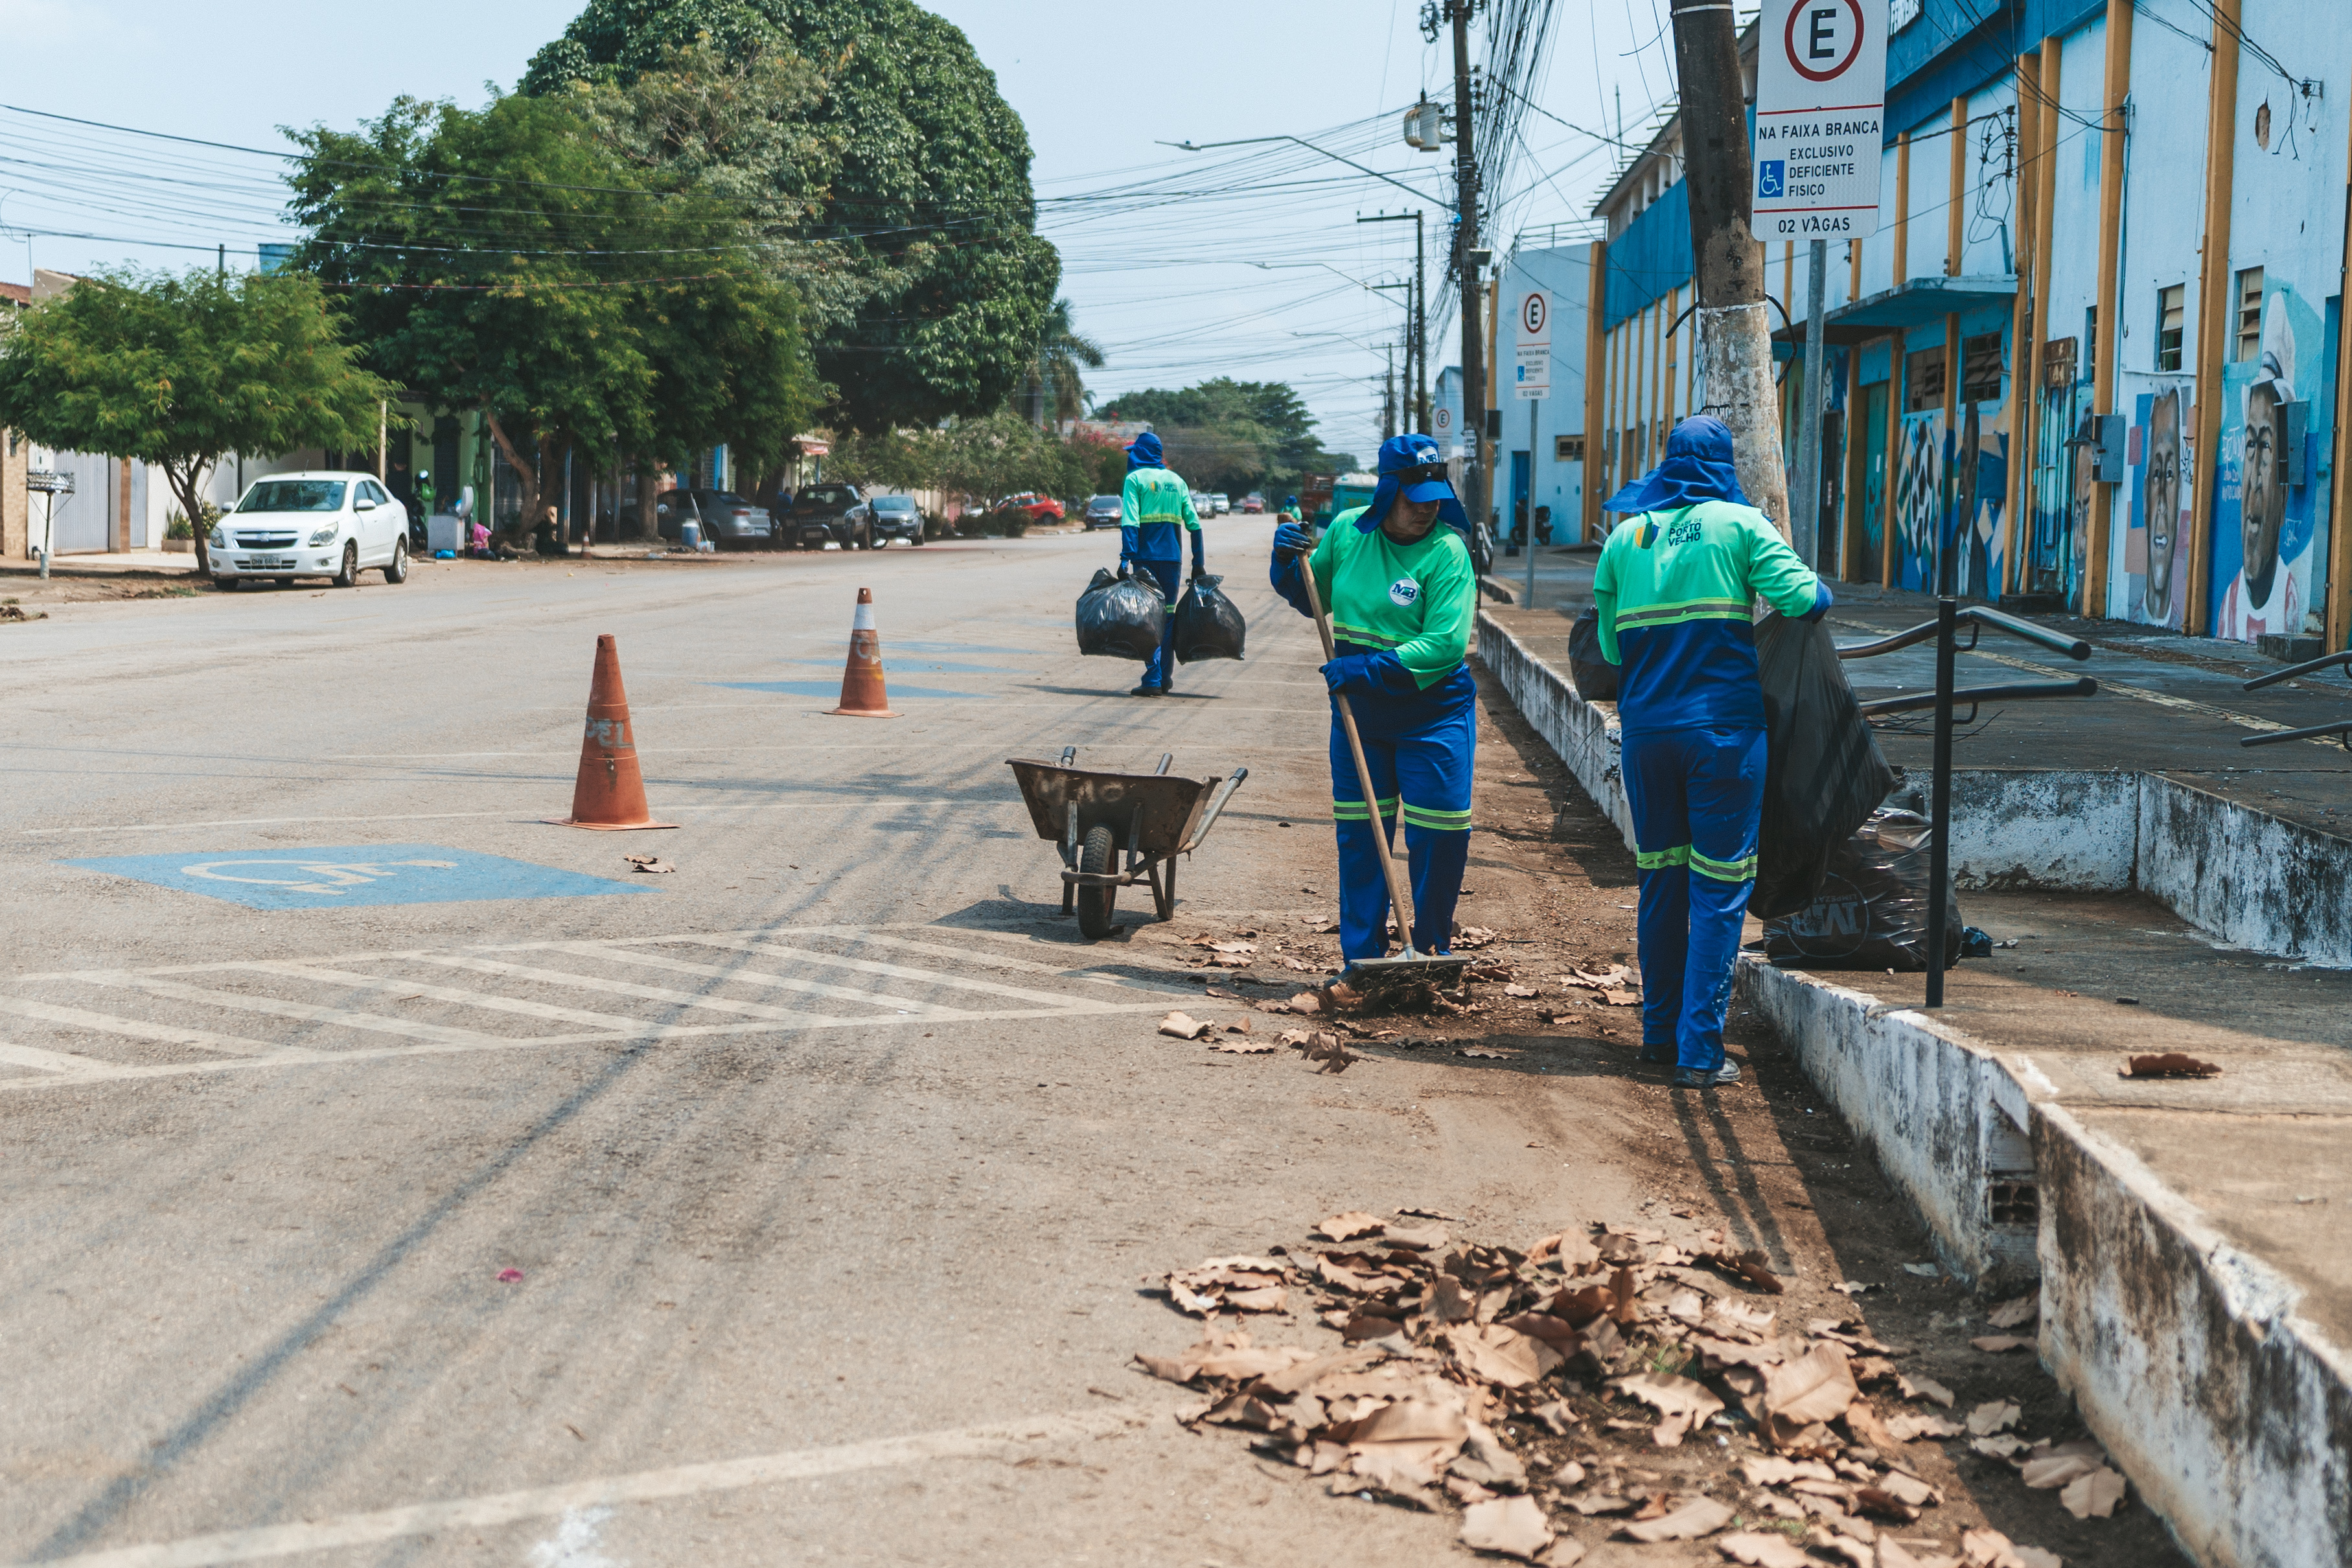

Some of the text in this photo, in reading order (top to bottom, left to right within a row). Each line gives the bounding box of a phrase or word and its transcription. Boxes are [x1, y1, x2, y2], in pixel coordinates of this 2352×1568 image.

[1809, 8, 1836, 59] E
[1758, 121, 1879, 140] NA FAIXA BRANCA
[1790, 144, 1854, 160] EXCLUSIVO
[1789, 163, 1854, 178] DEFICIENTE
[1789, 184, 1825, 197] FISICO
[1778, 217, 1850, 233] 02 VAGAS
[1531, 304, 1538, 324] E
[1441, 413, 1446, 424] E
[1668, 522, 1701, 537] PORTO
[1668, 531, 1701, 547] VELHO
[1392, 583, 1416, 598] MB
[1818, 894, 1856, 903] LIMPEZA
